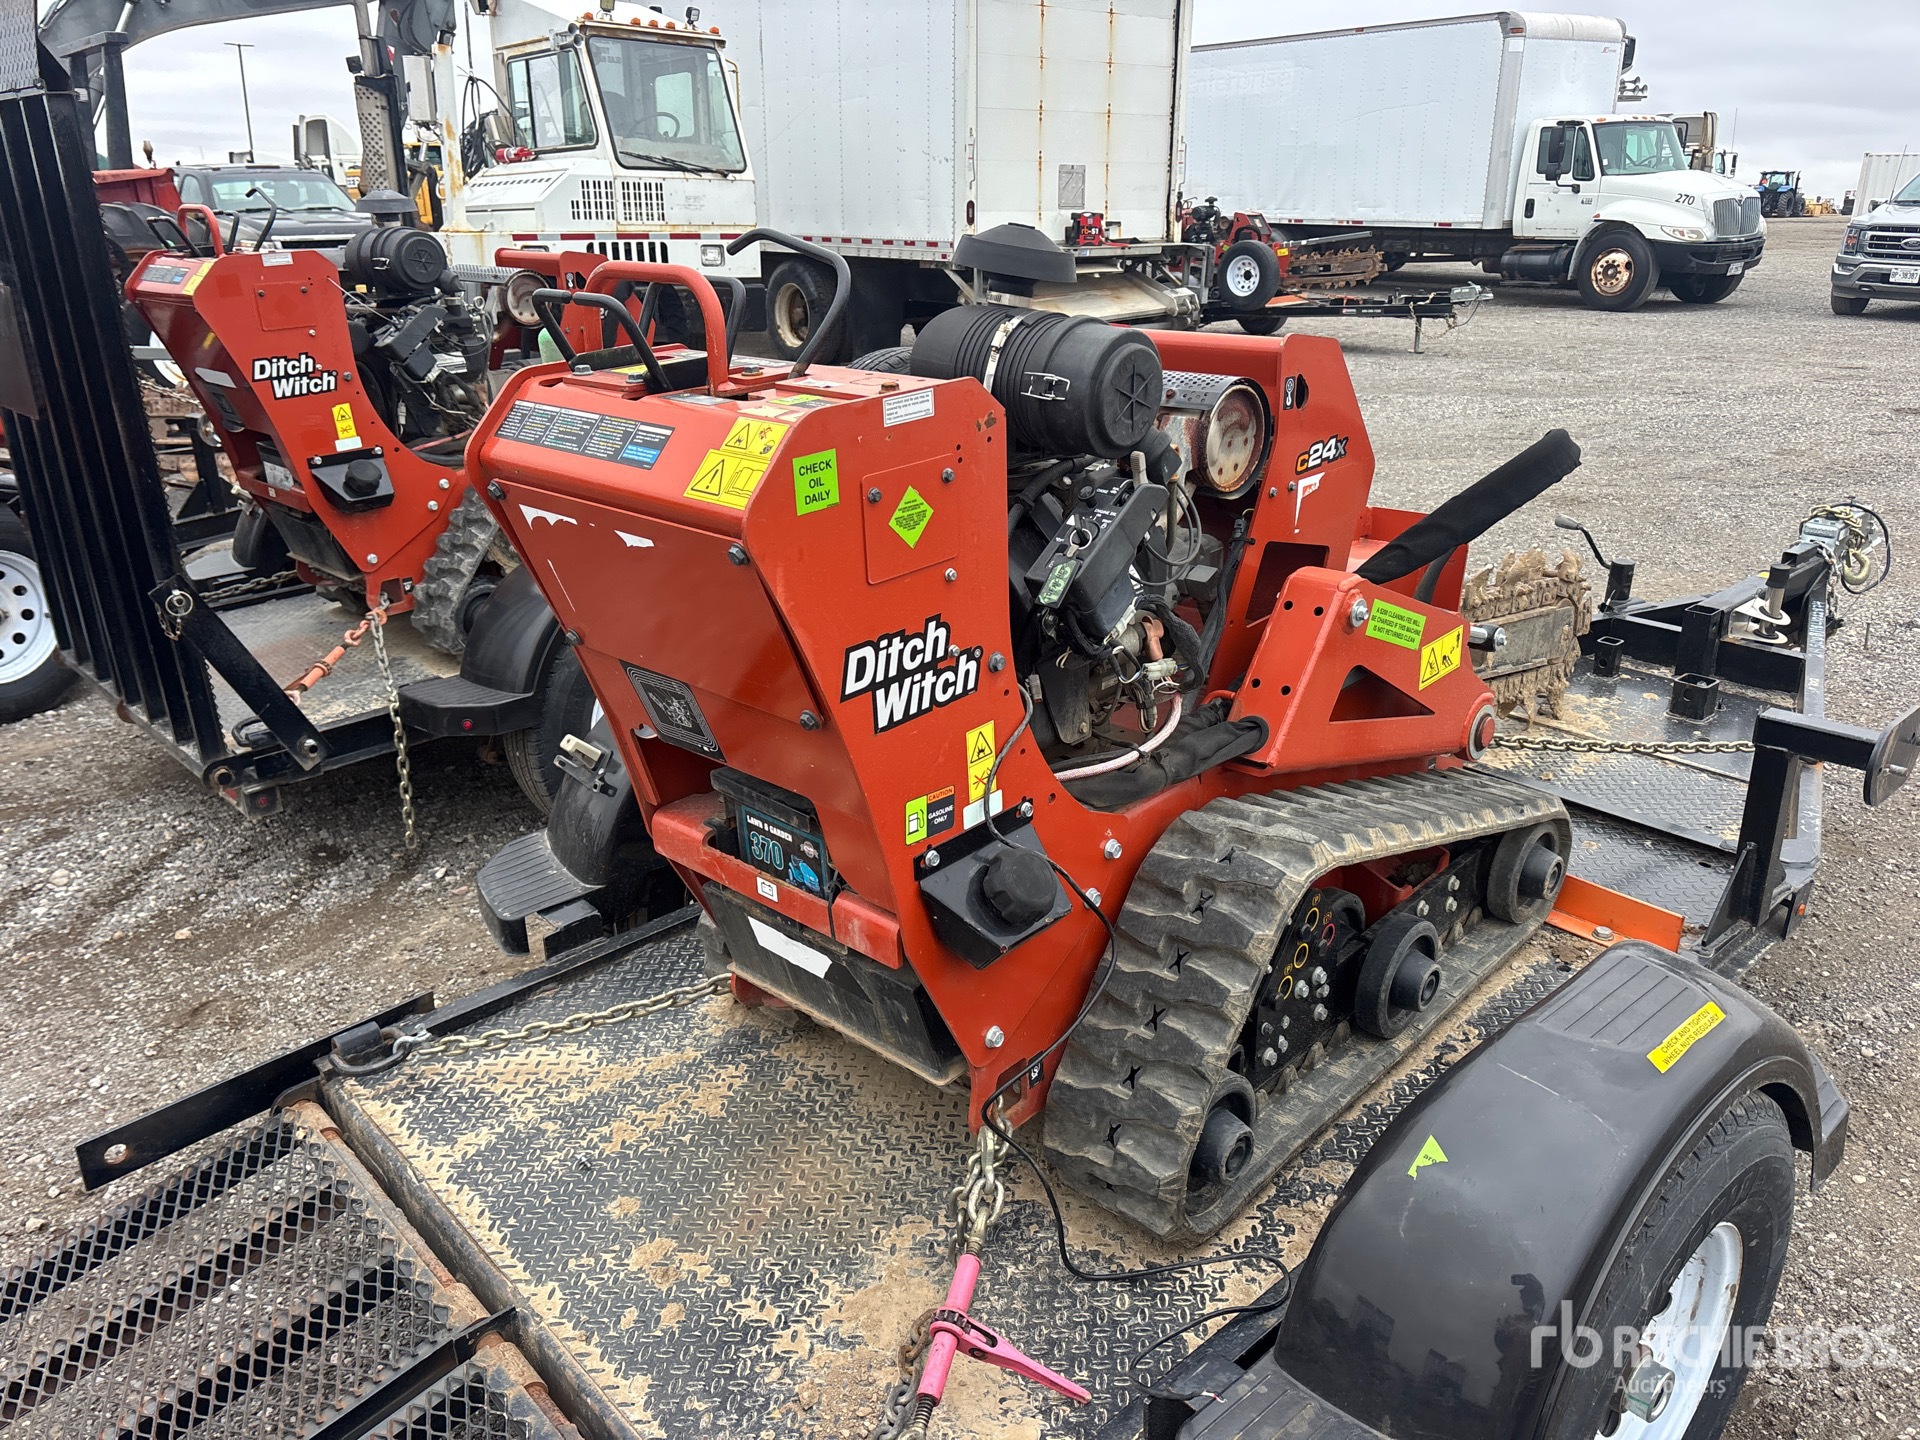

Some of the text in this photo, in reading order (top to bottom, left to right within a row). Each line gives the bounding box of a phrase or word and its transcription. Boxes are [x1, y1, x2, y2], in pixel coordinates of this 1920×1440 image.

[1675, 193, 1695, 206] 270
[253, 353, 314, 380] Ditch
[272, 372, 335, 398] Witch
[798, 459, 832, 477] CHECK
[808, 477, 825, 489] OIL
[804, 489, 831, 506] DAILY
[845, 620, 947, 695] Ditch
[875, 654, 977, 729] Witch
[928, 788, 953, 801] CAUTION
[928, 804, 954, 819] GASOLINE
[933, 814, 948, 825] ONLY
[746, 814, 763, 829] LAWN
[769, 825, 793, 842] GARDEN
[750, 831, 784, 870] 370
[1661, 1009, 1710, 1054] CHECK AND TIGHTEN
[1662, 1013, 1720, 1065] WHEEL NUTS REGULARLY
